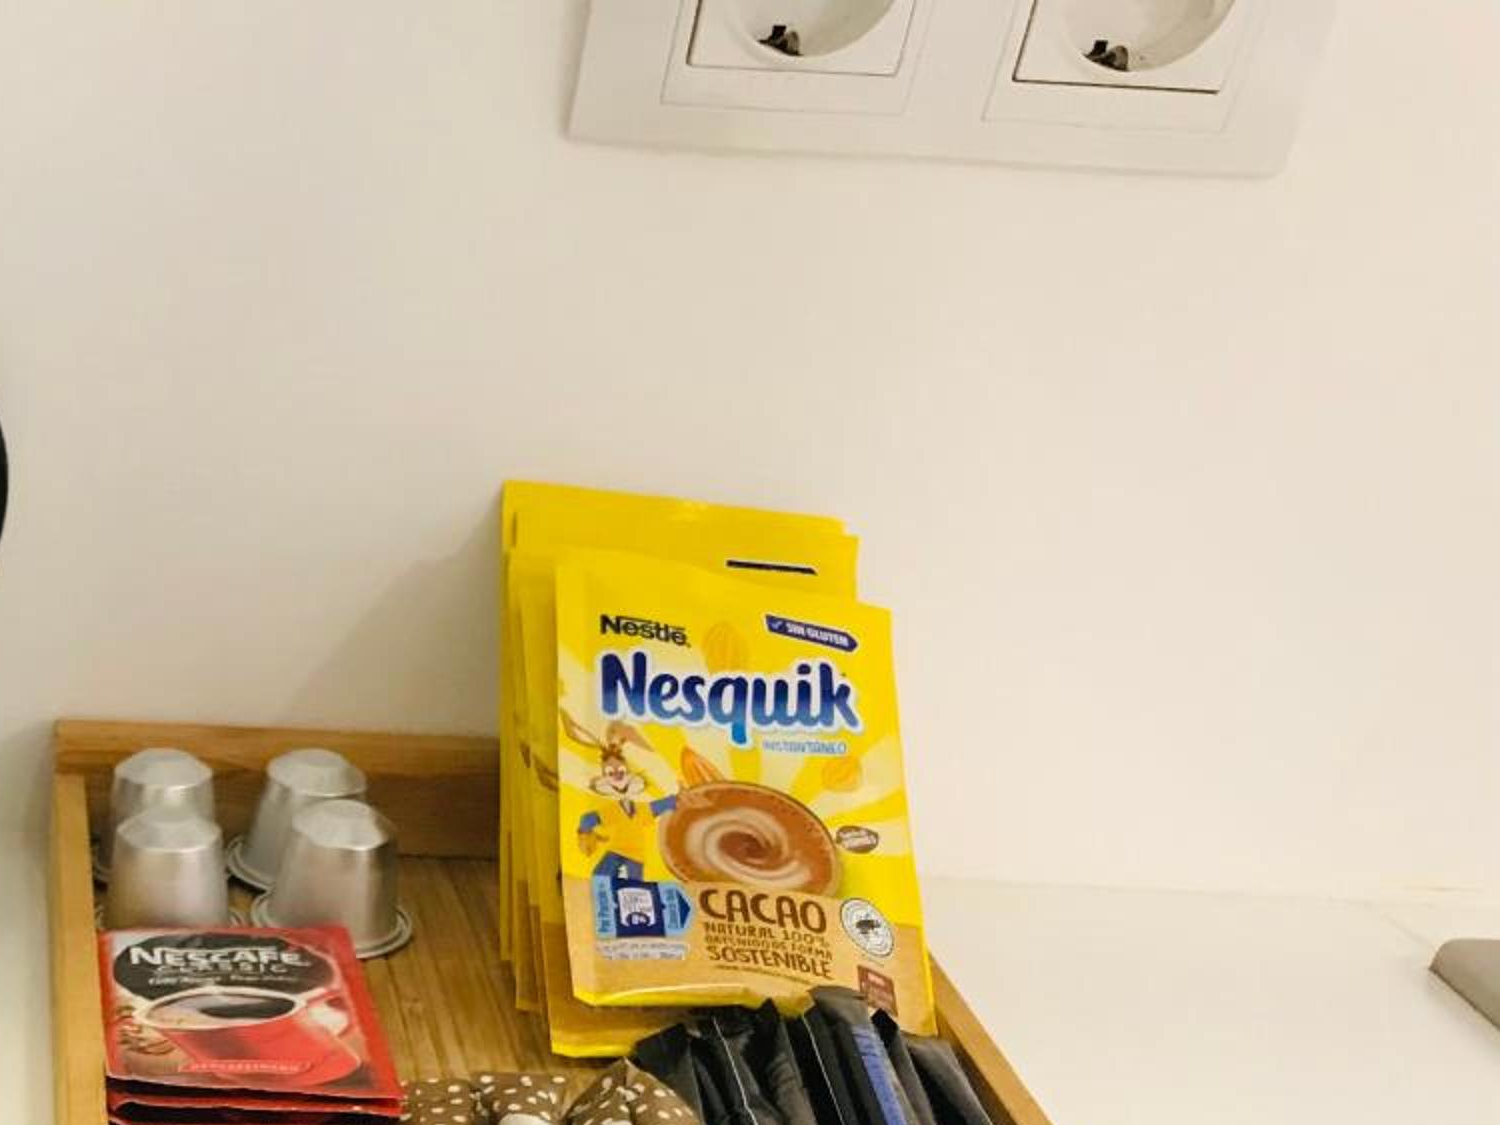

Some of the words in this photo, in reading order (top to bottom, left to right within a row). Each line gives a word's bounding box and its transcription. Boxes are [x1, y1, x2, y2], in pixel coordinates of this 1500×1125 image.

[601, 652, 860, 745] Nesquik
[699, 888, 827, 934] CACAO
[704, 922, 775, 940] NATURAL
[706, 945, 834, 980] SOSTENIBLE
